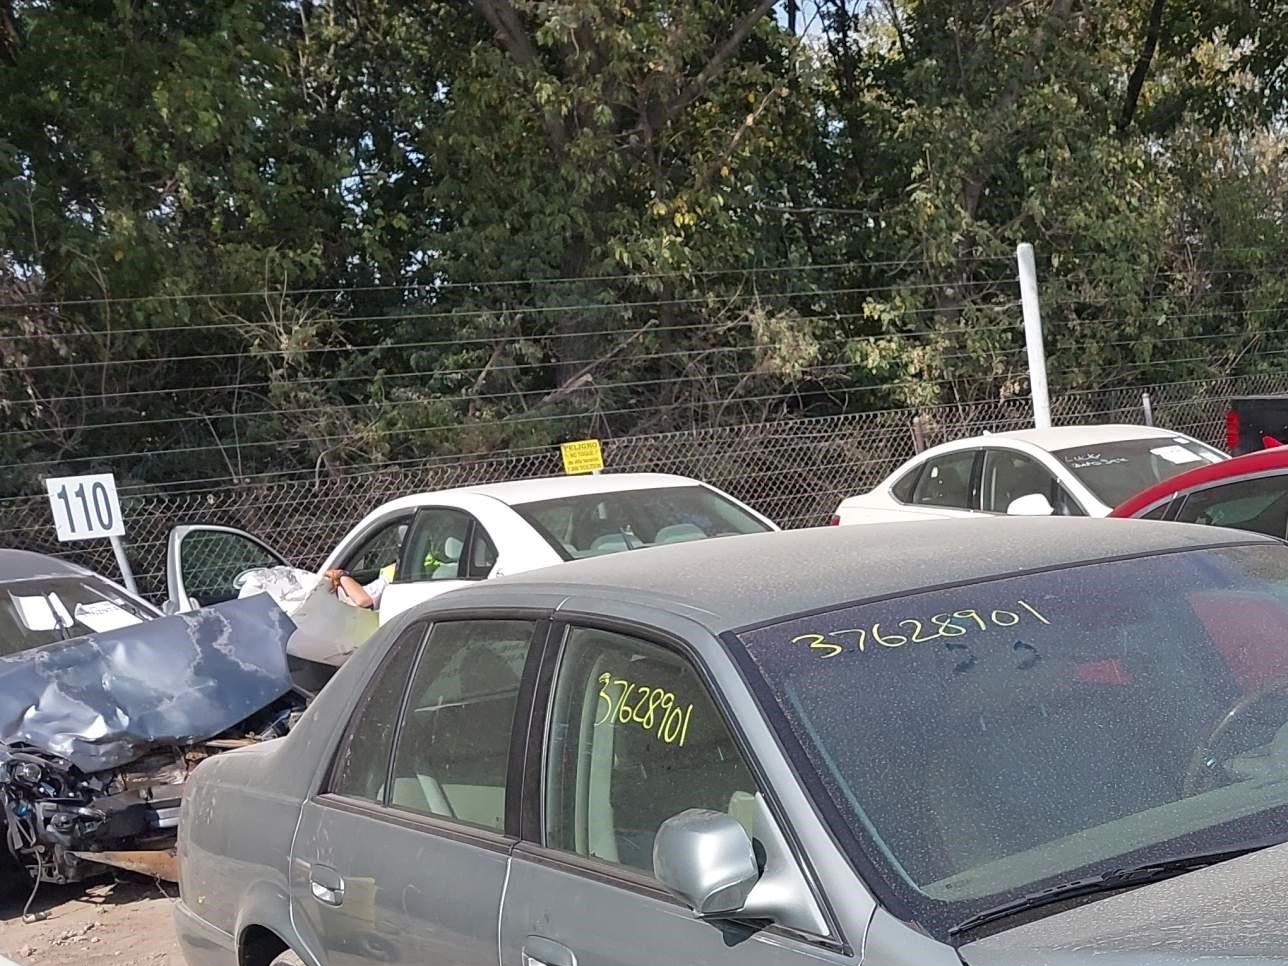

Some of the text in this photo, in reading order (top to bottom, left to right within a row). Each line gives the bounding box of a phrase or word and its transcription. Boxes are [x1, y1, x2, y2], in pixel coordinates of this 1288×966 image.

[57, 481, 113, 533] 110
[792, 600, 1050, 659] 37628901
[594, 672, 693, 747] 37628901
